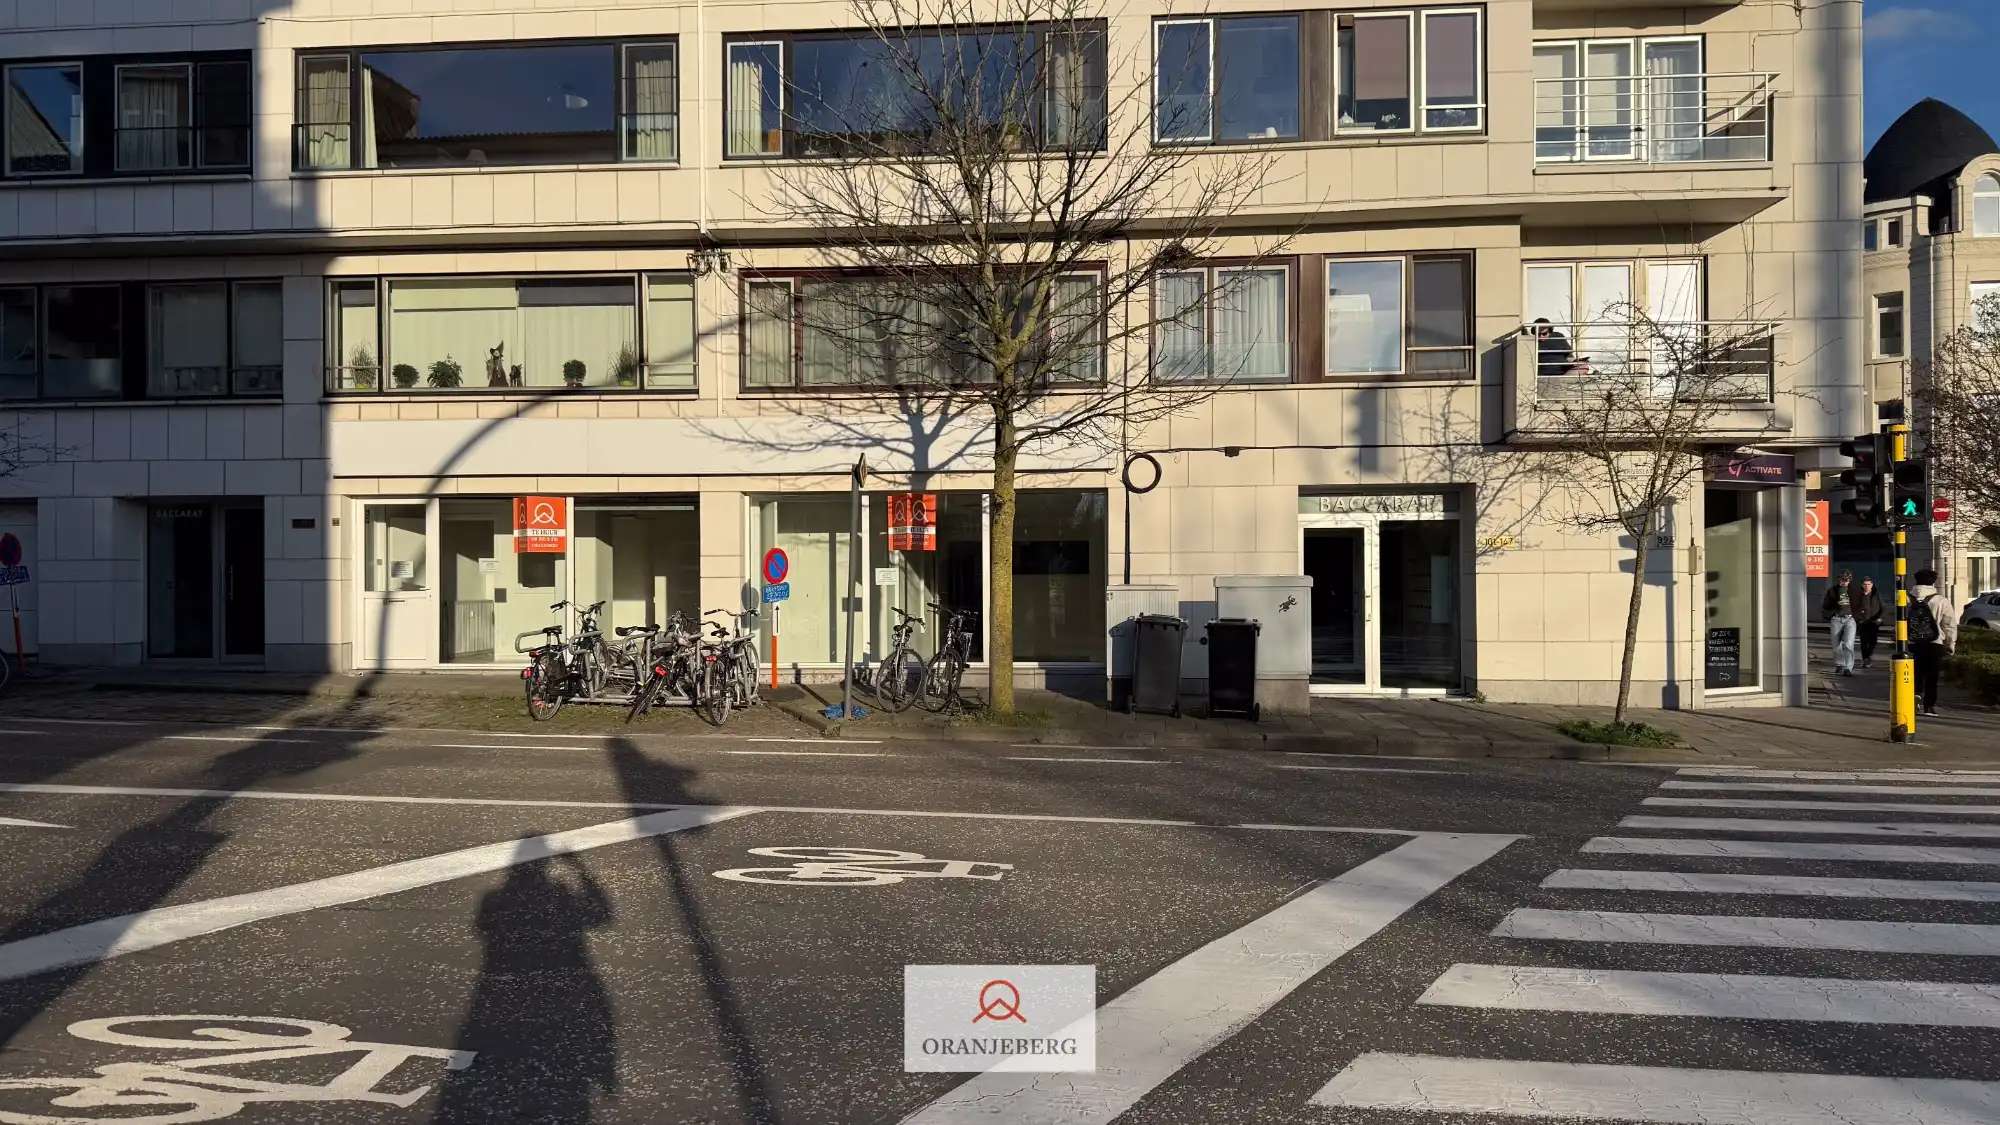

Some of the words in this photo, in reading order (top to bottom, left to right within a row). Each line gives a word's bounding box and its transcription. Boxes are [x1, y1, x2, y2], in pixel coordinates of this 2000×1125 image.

[1744, 466, 1782, 475] ACTIVATE
[1320, 496, 1435, 512] BACCARAT
[1805, 546, 1824, 554] UUR
